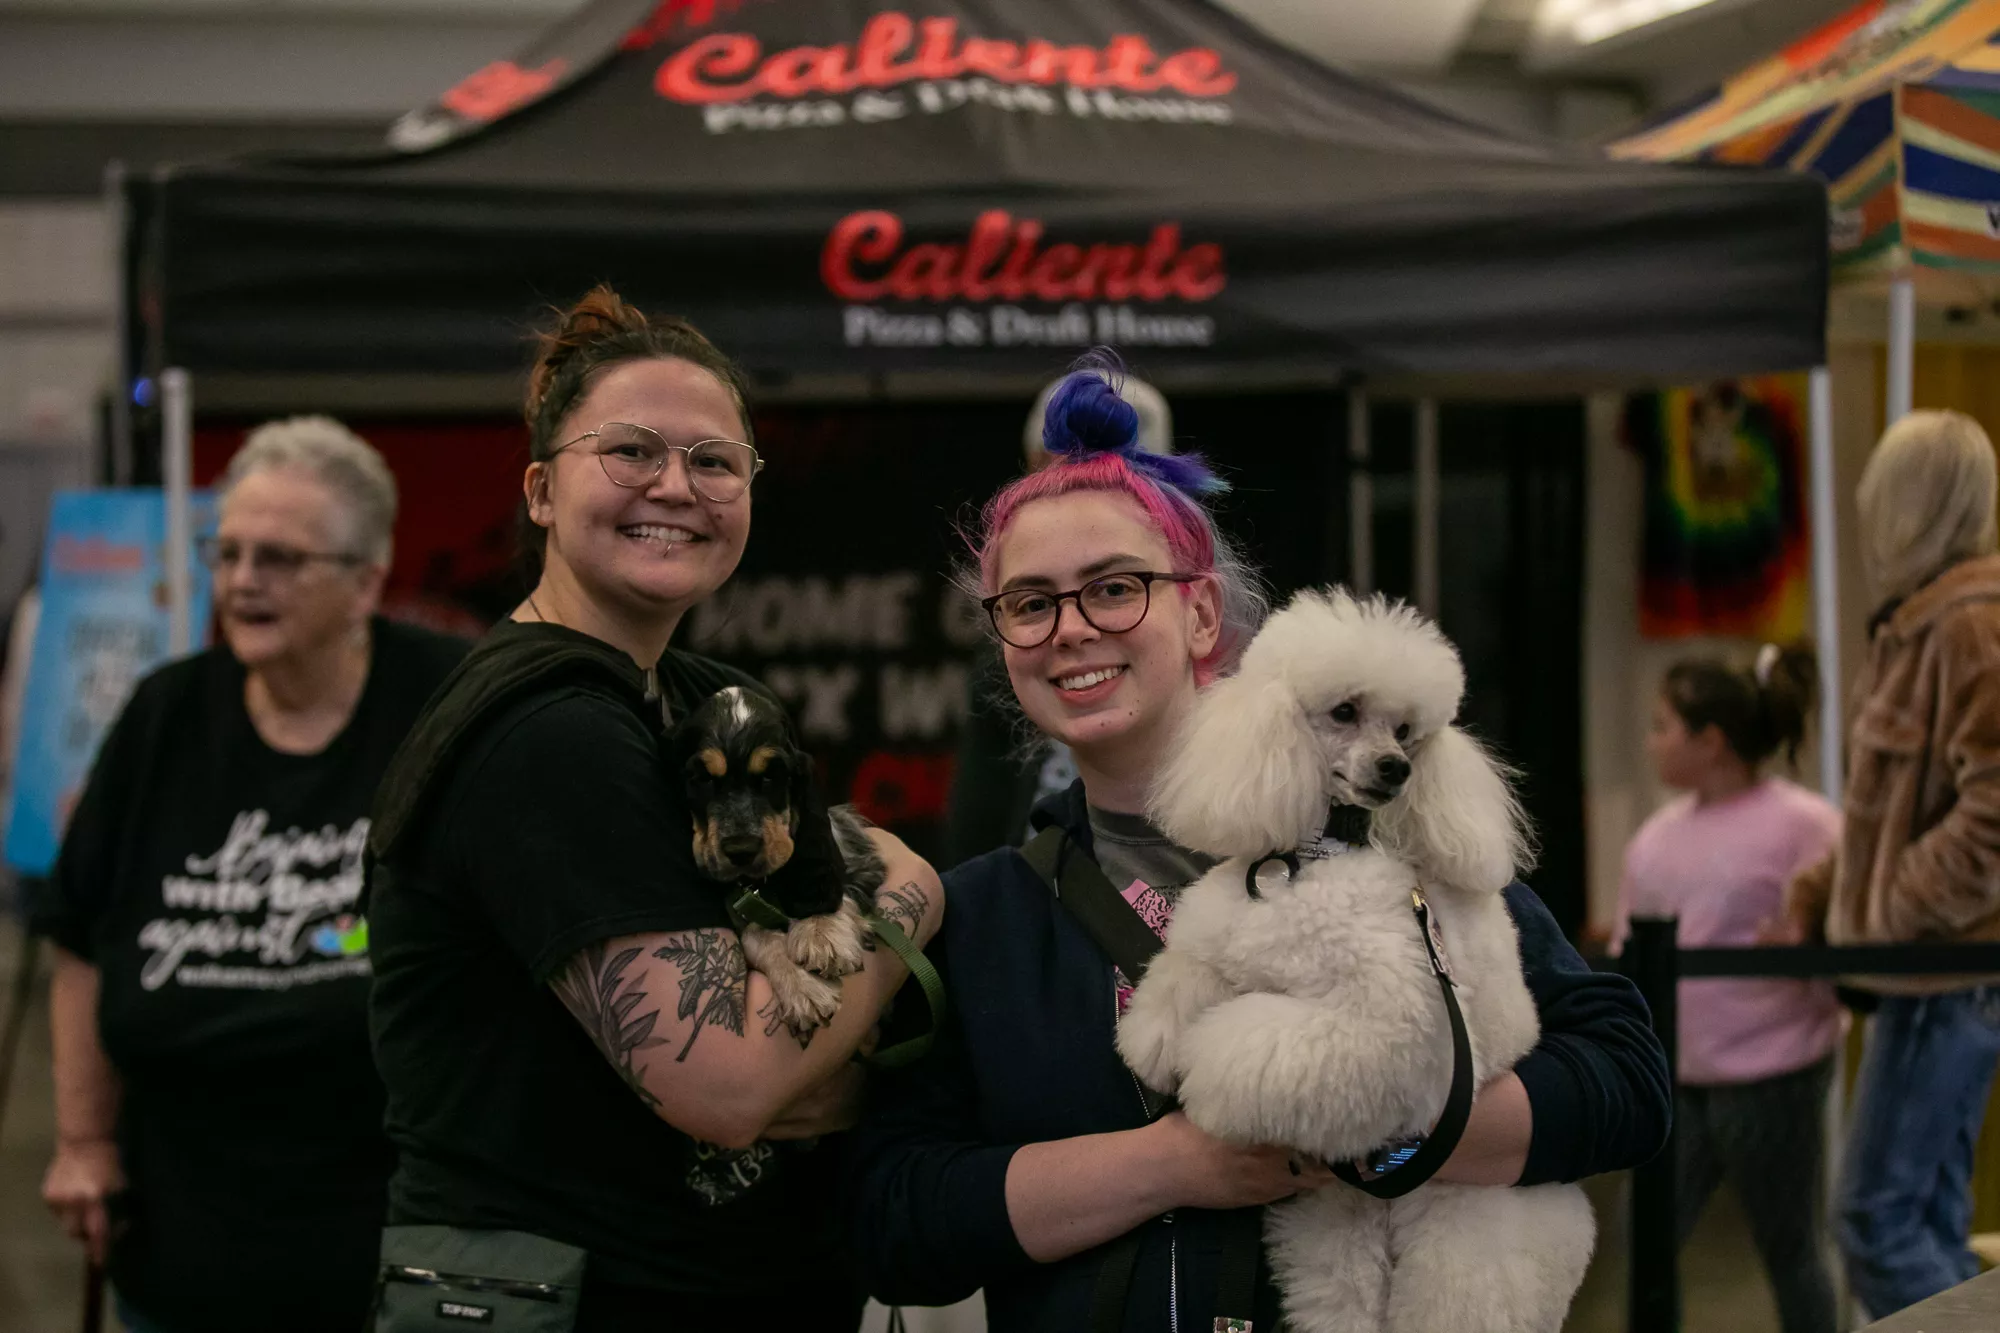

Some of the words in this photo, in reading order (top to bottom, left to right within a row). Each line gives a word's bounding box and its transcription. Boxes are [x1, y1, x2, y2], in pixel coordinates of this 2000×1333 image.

[655, 11, 1238, 103] Caliente
[821, 209, 1226, 301] Caliente
[844, 306, 941, 346] Pizza
[946, 306, 983, 345] &
[990, 303, 1089, 345] Draft
[1095, 304, 1213, 346] House
